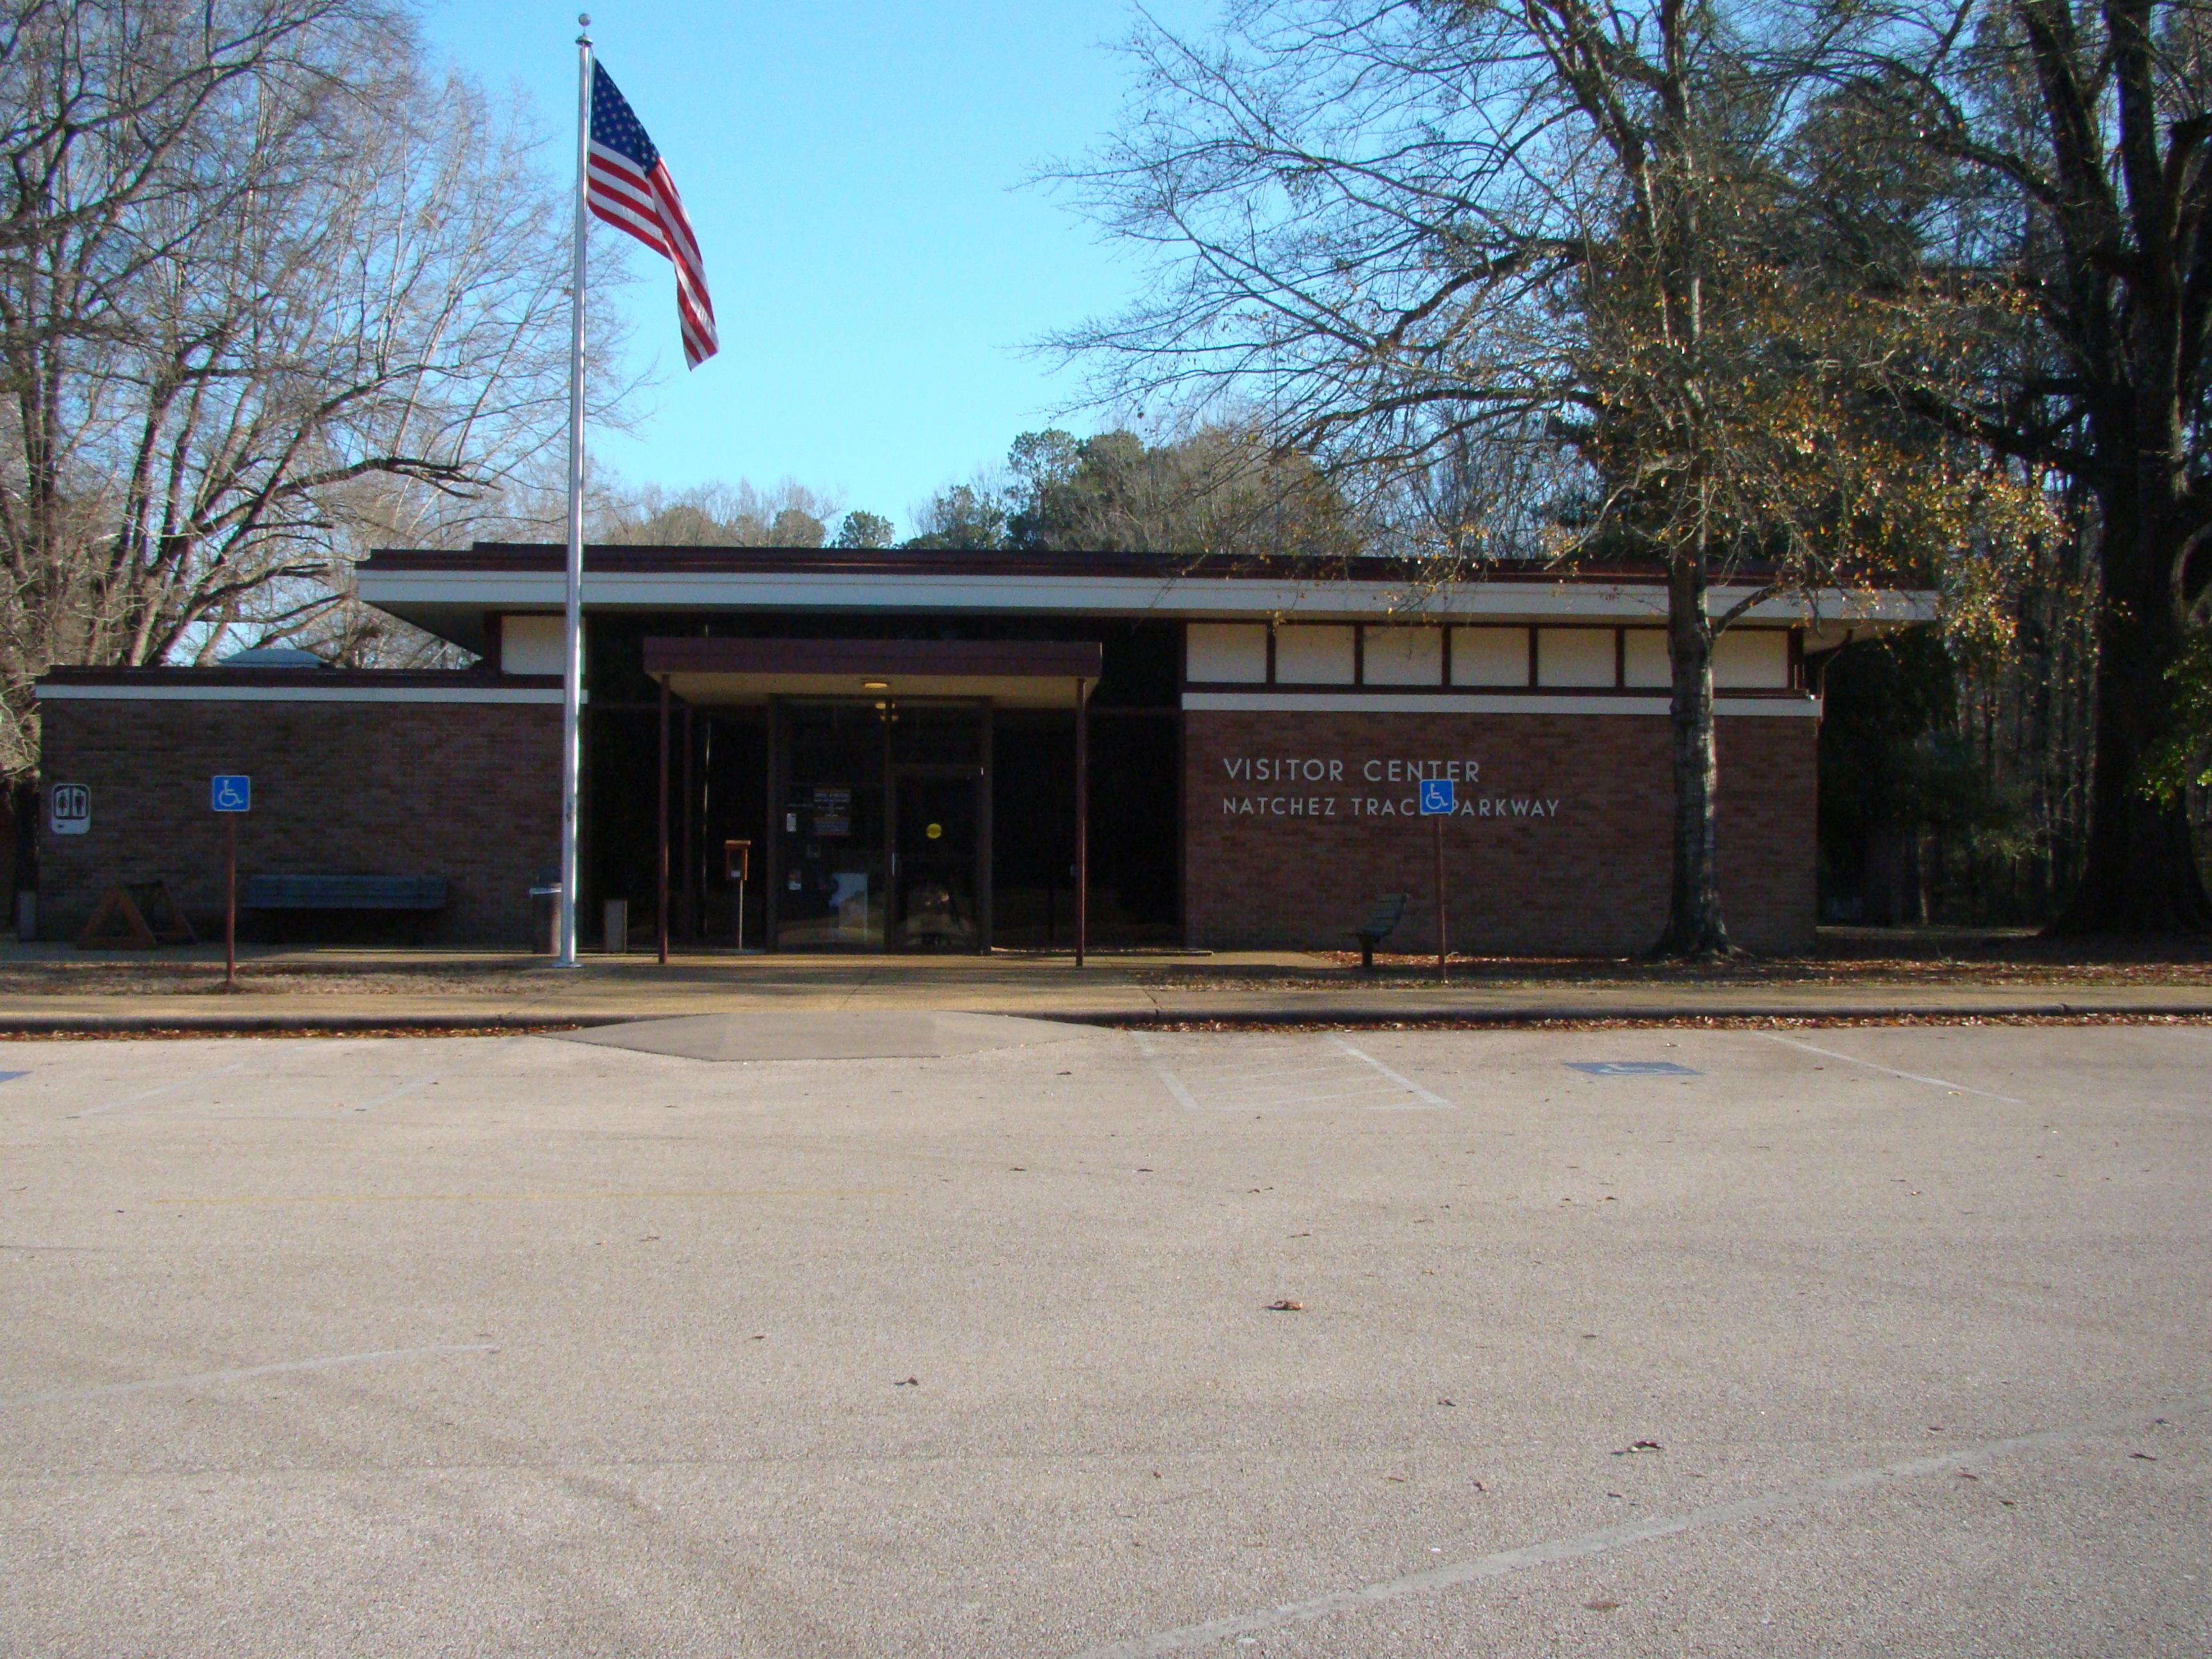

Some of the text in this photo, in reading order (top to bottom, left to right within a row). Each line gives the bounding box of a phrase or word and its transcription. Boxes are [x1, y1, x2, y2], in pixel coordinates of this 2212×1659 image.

[1222, 758, 1480, 783] VISITOR CENTER
[1222, 796, 1336, 816] NATCHEZ
[1351, 797, 1430, 817] TRAC
